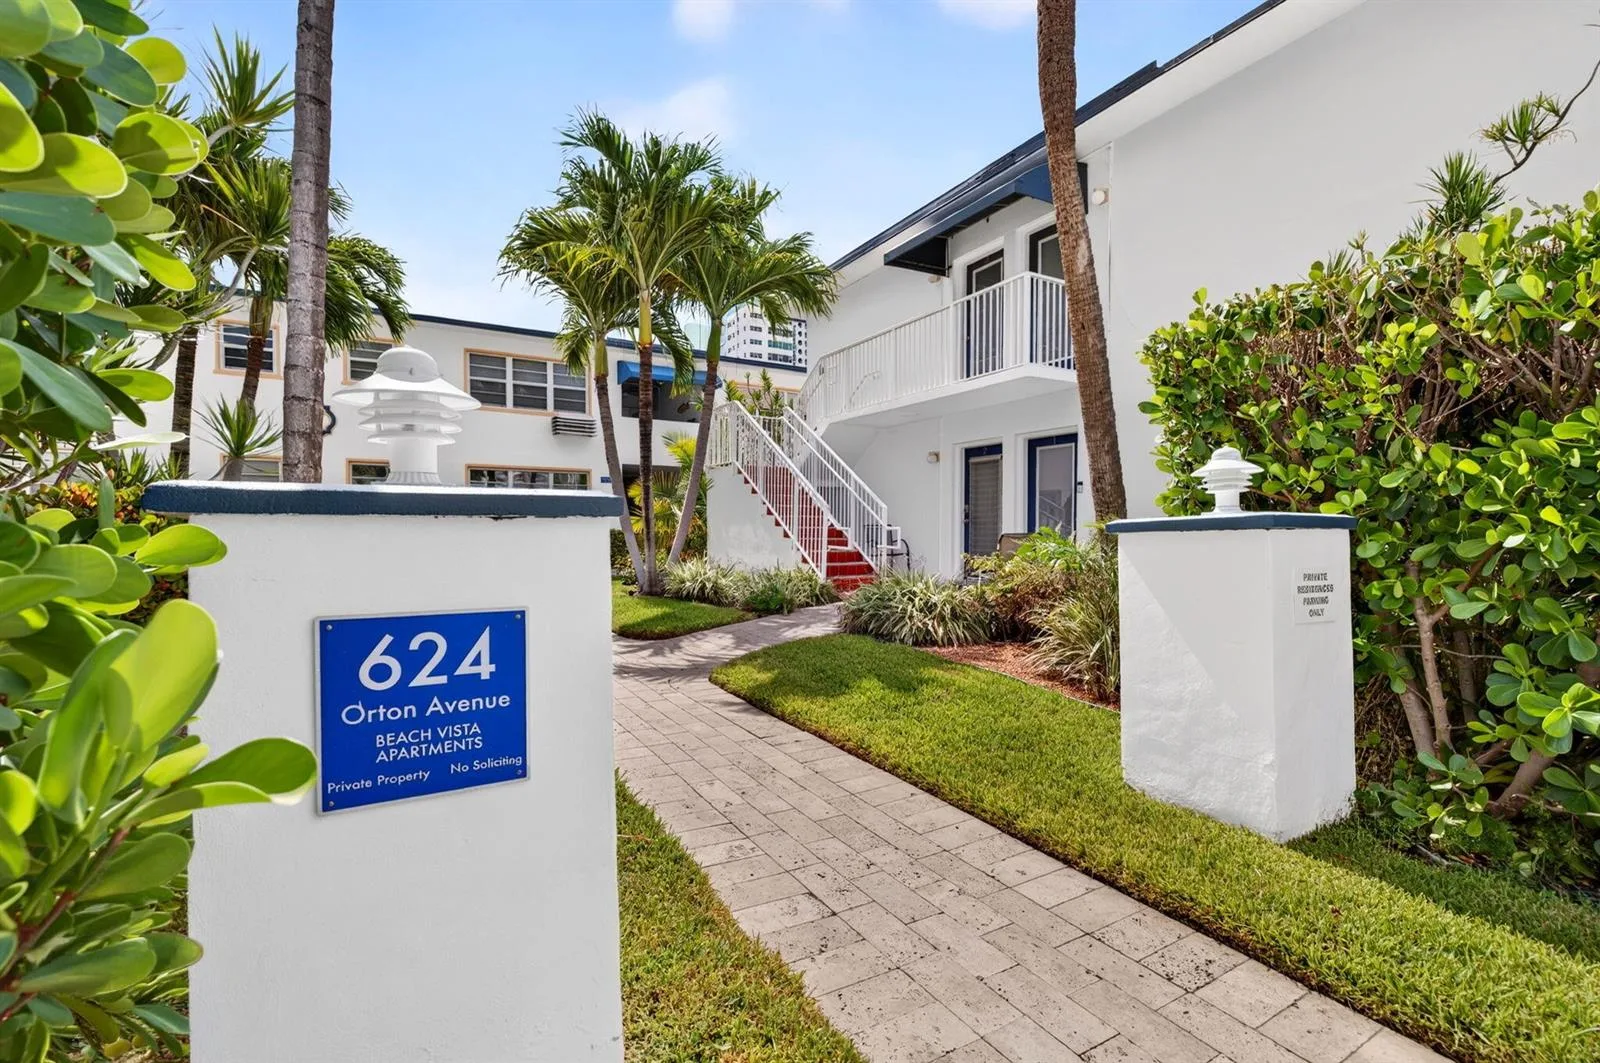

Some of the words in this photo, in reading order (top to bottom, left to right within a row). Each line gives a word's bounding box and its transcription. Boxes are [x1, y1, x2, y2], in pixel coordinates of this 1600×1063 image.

[1303, 572, 1328, 581] PRIVATE
[1303, 596, 1329, 605] PARKING
[1308, 608, 1325, 617] ONLY
[358, 625, 496, 691] 624
[341, 701, 417, 725] Orton
[425, 694, 511, 716] Avenue
[376, 728, 431, 748] BEACH
[437, 722, 481, 738] VISTA
[375, 736, 483, 763] APARTMENTS
[451, 762, 469, 774] No
[472, 755, 522, 771] Soliciting
[327, 778, 373, 794] Private
[377, 769, 430, 786] Property
